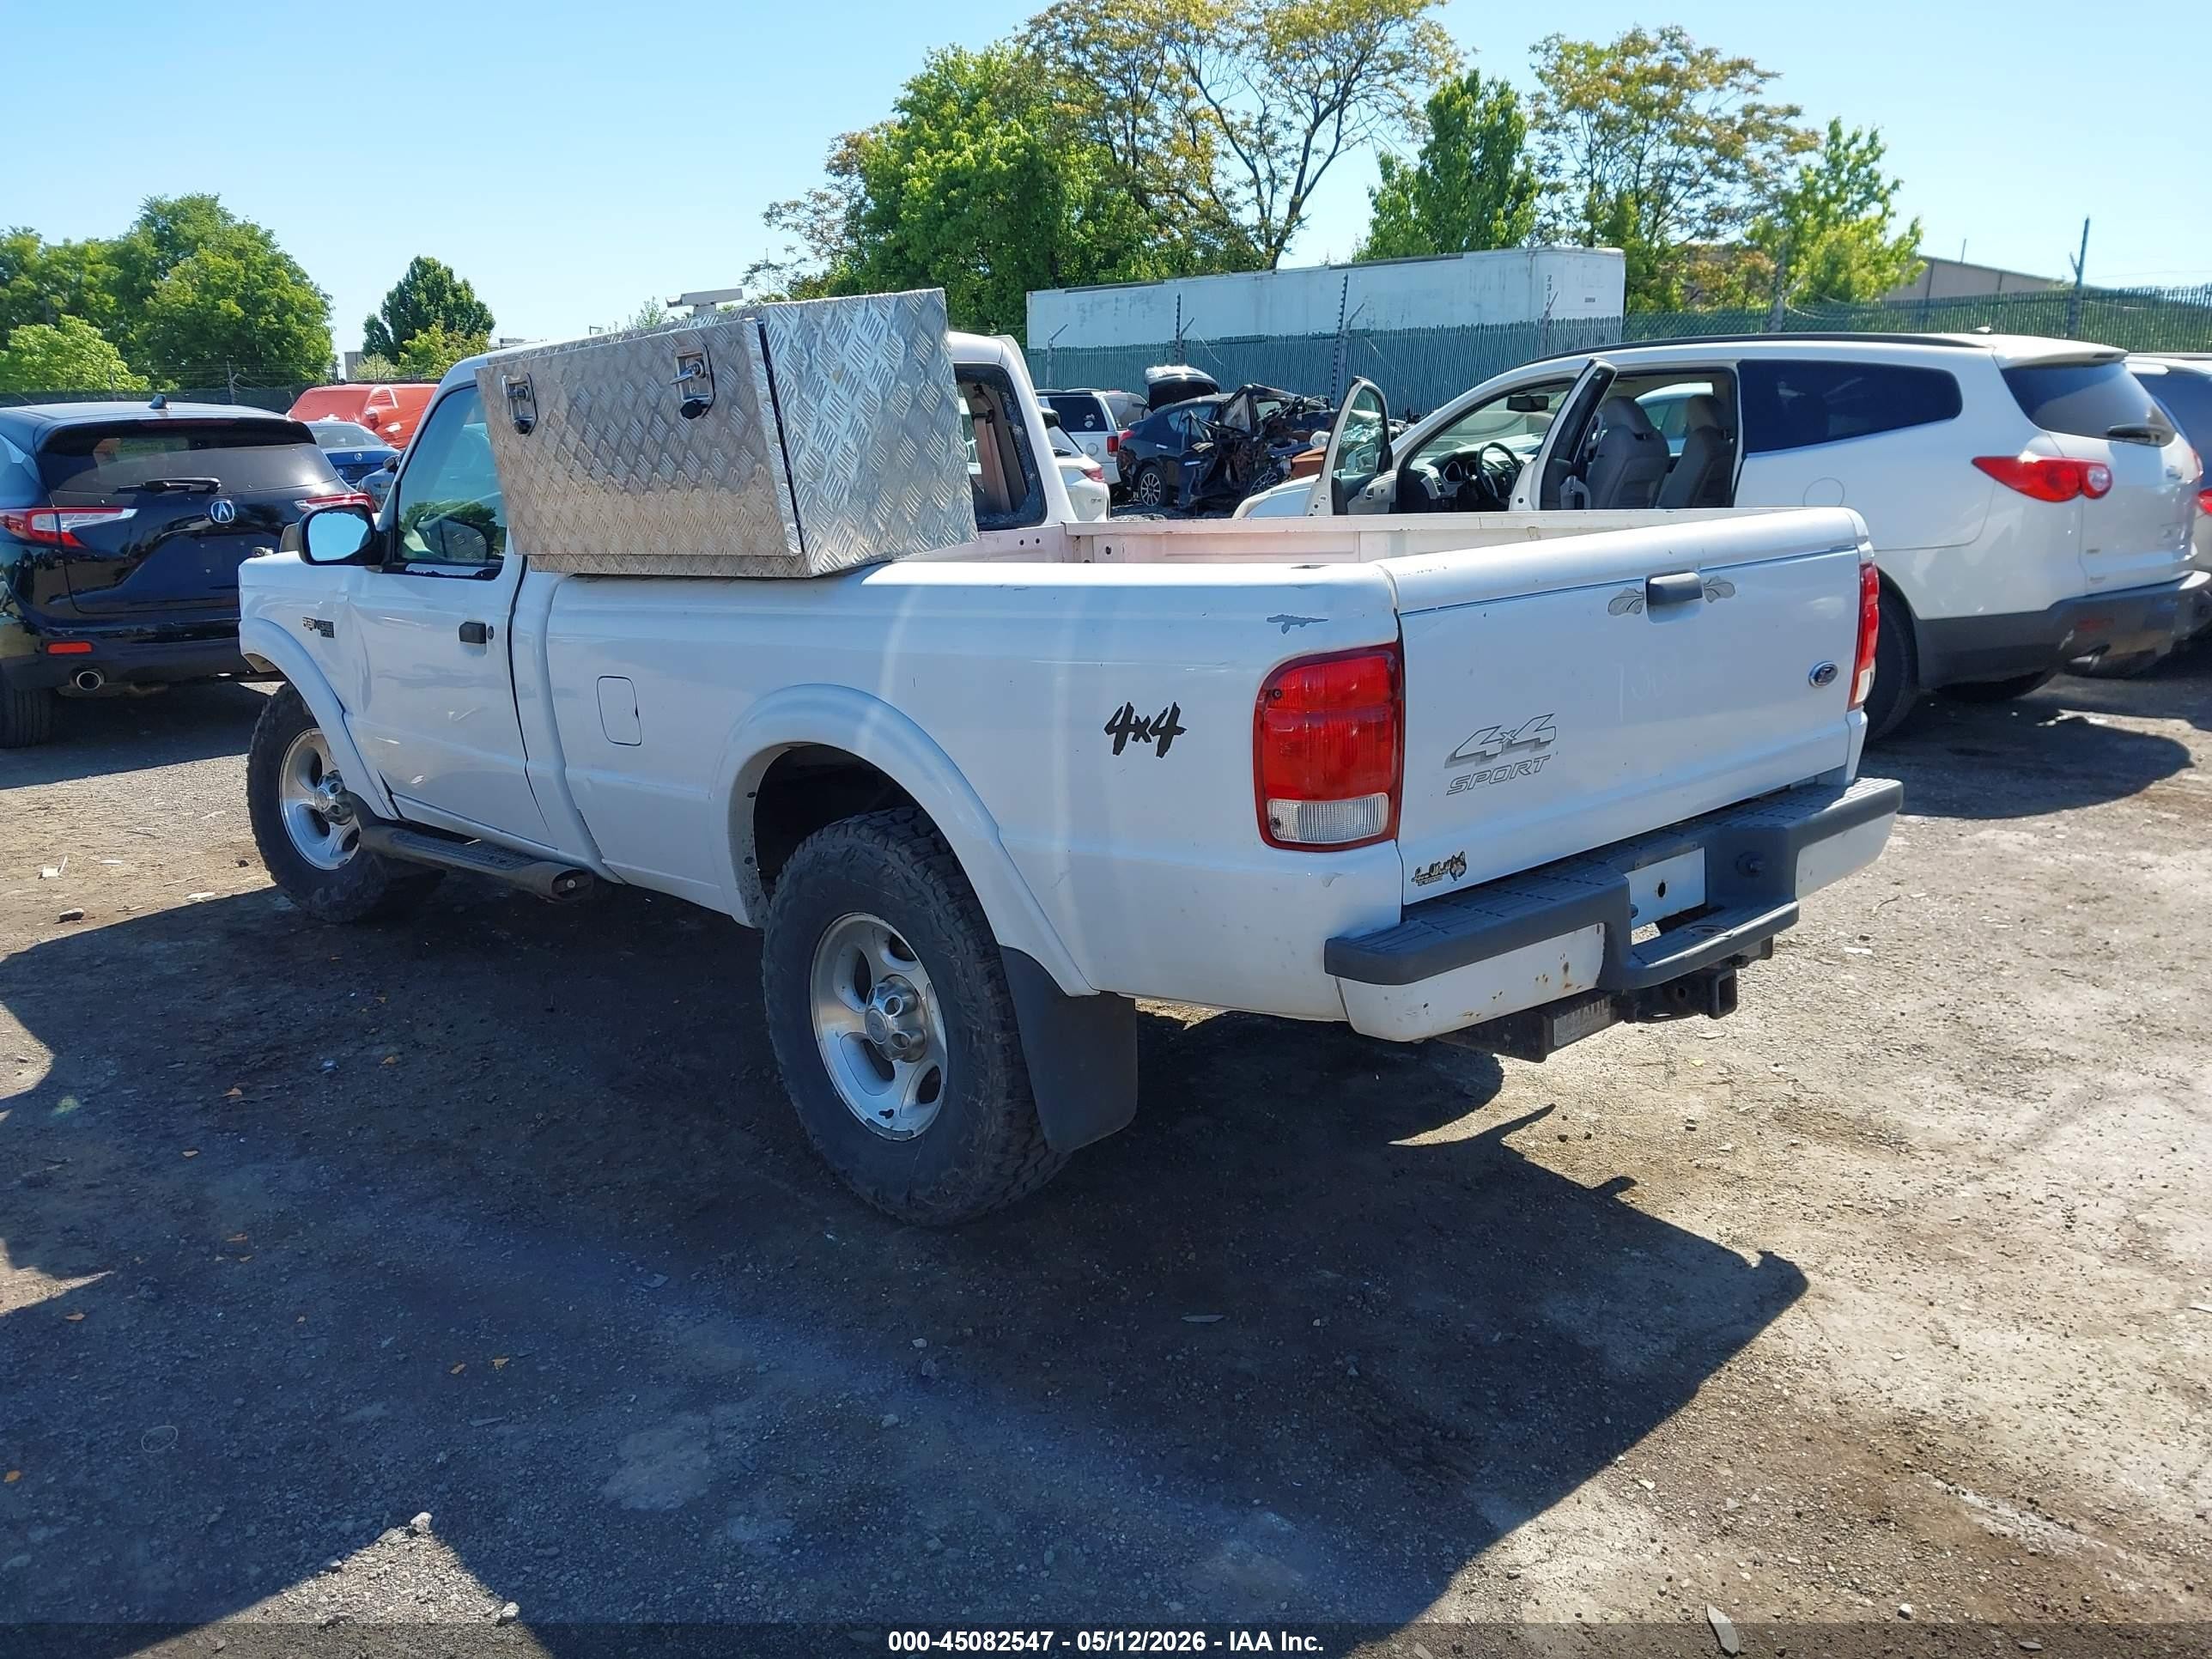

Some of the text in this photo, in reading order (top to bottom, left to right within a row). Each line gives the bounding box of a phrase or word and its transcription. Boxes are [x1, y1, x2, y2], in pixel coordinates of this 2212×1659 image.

[1103, 702, 1188, 758] 4x4
[1446, 714, 1556, 768] 4x4
[1446, 755, 1551, 796] SPORT
